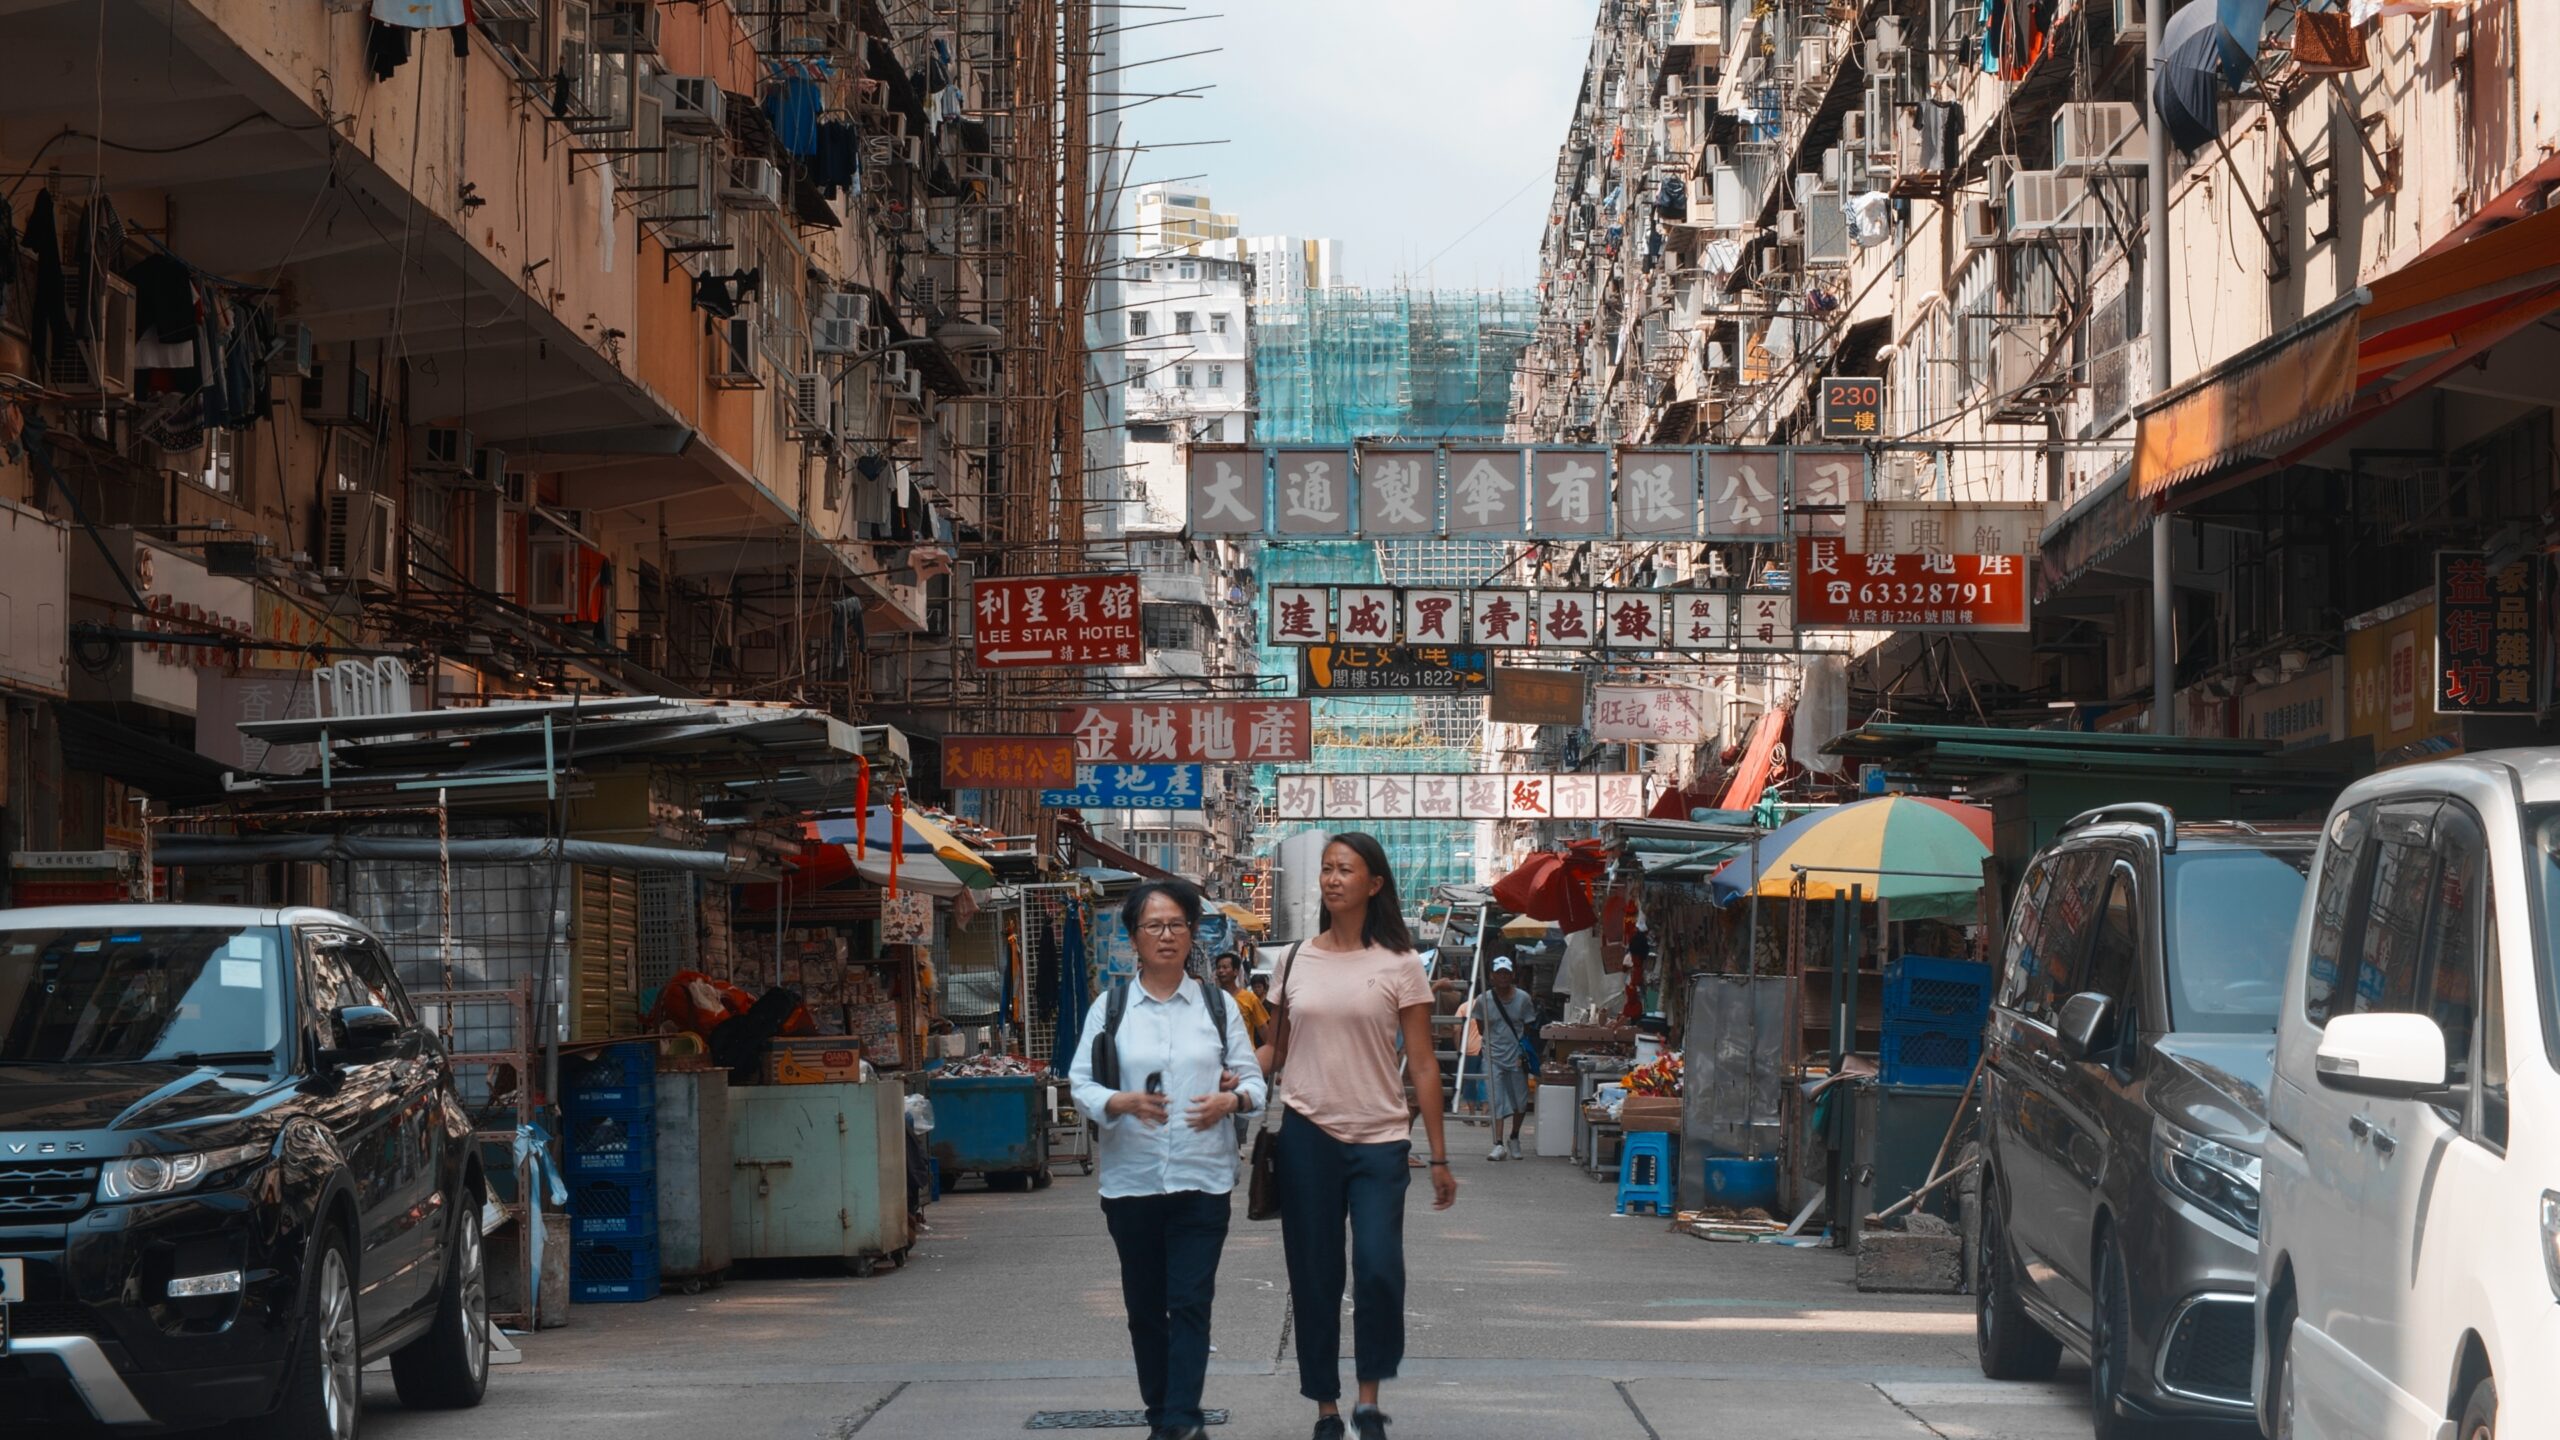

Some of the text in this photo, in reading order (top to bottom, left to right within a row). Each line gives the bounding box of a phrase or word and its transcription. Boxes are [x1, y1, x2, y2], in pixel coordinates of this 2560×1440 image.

[1830, 386, 1878, 406] 230
[1831, 411, 1876, 431] 一樓
[1201, 458, 1850, 528] 大通製傘有限公司
[1859, 582, 1994, 604] 63328791
[979, 625, 1135, 644] LEE STAR HOTEL
[2445, 558, 2494, 706] 益街坊
[1060, 644, 1132, 661] 請上二樓
[1370, 669, 1410, 687] 5126
[1414, 670, 1453, 687] 1822
[1075, 706, 1297, 760] 金城地產
[1041, 793, 1185, 808] 386 8683
